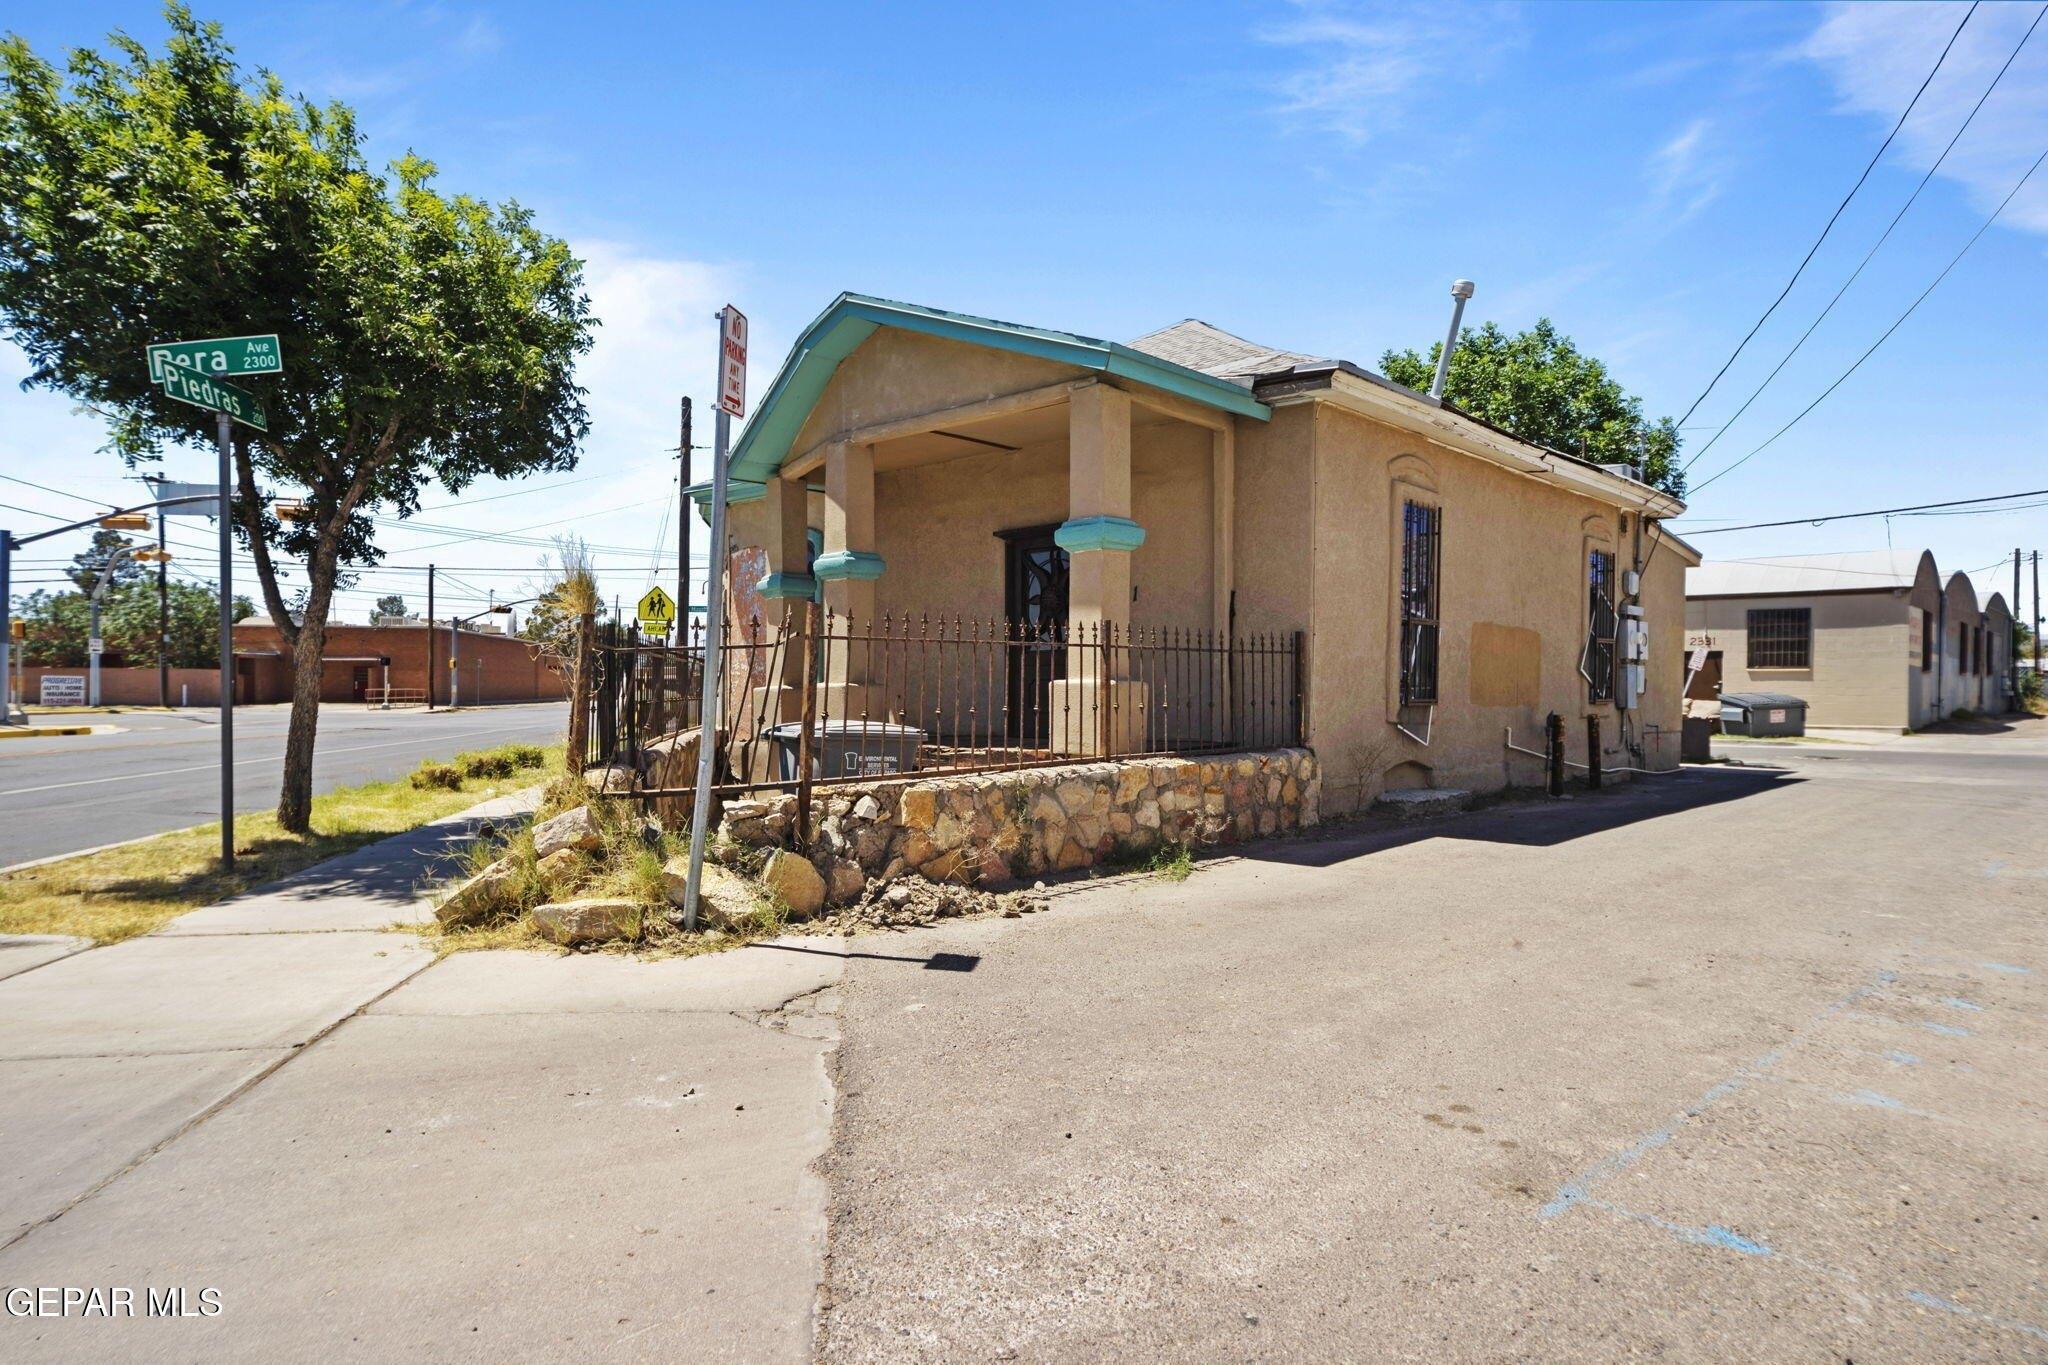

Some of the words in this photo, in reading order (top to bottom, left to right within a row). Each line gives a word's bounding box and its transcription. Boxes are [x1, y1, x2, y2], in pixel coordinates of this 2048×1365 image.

[732, 318, 742, 340] NO
[246, 341, 269, 354] Ave
[725, 337, 746, 366] PARKING
[153, 349, 228, 377] Pera
[243, 354, 276, 369] 2300
[729, 362, 740, 379] ANY
[164, 363, 241, 416] Piedras
[728, 377, 740, 395] TIME
